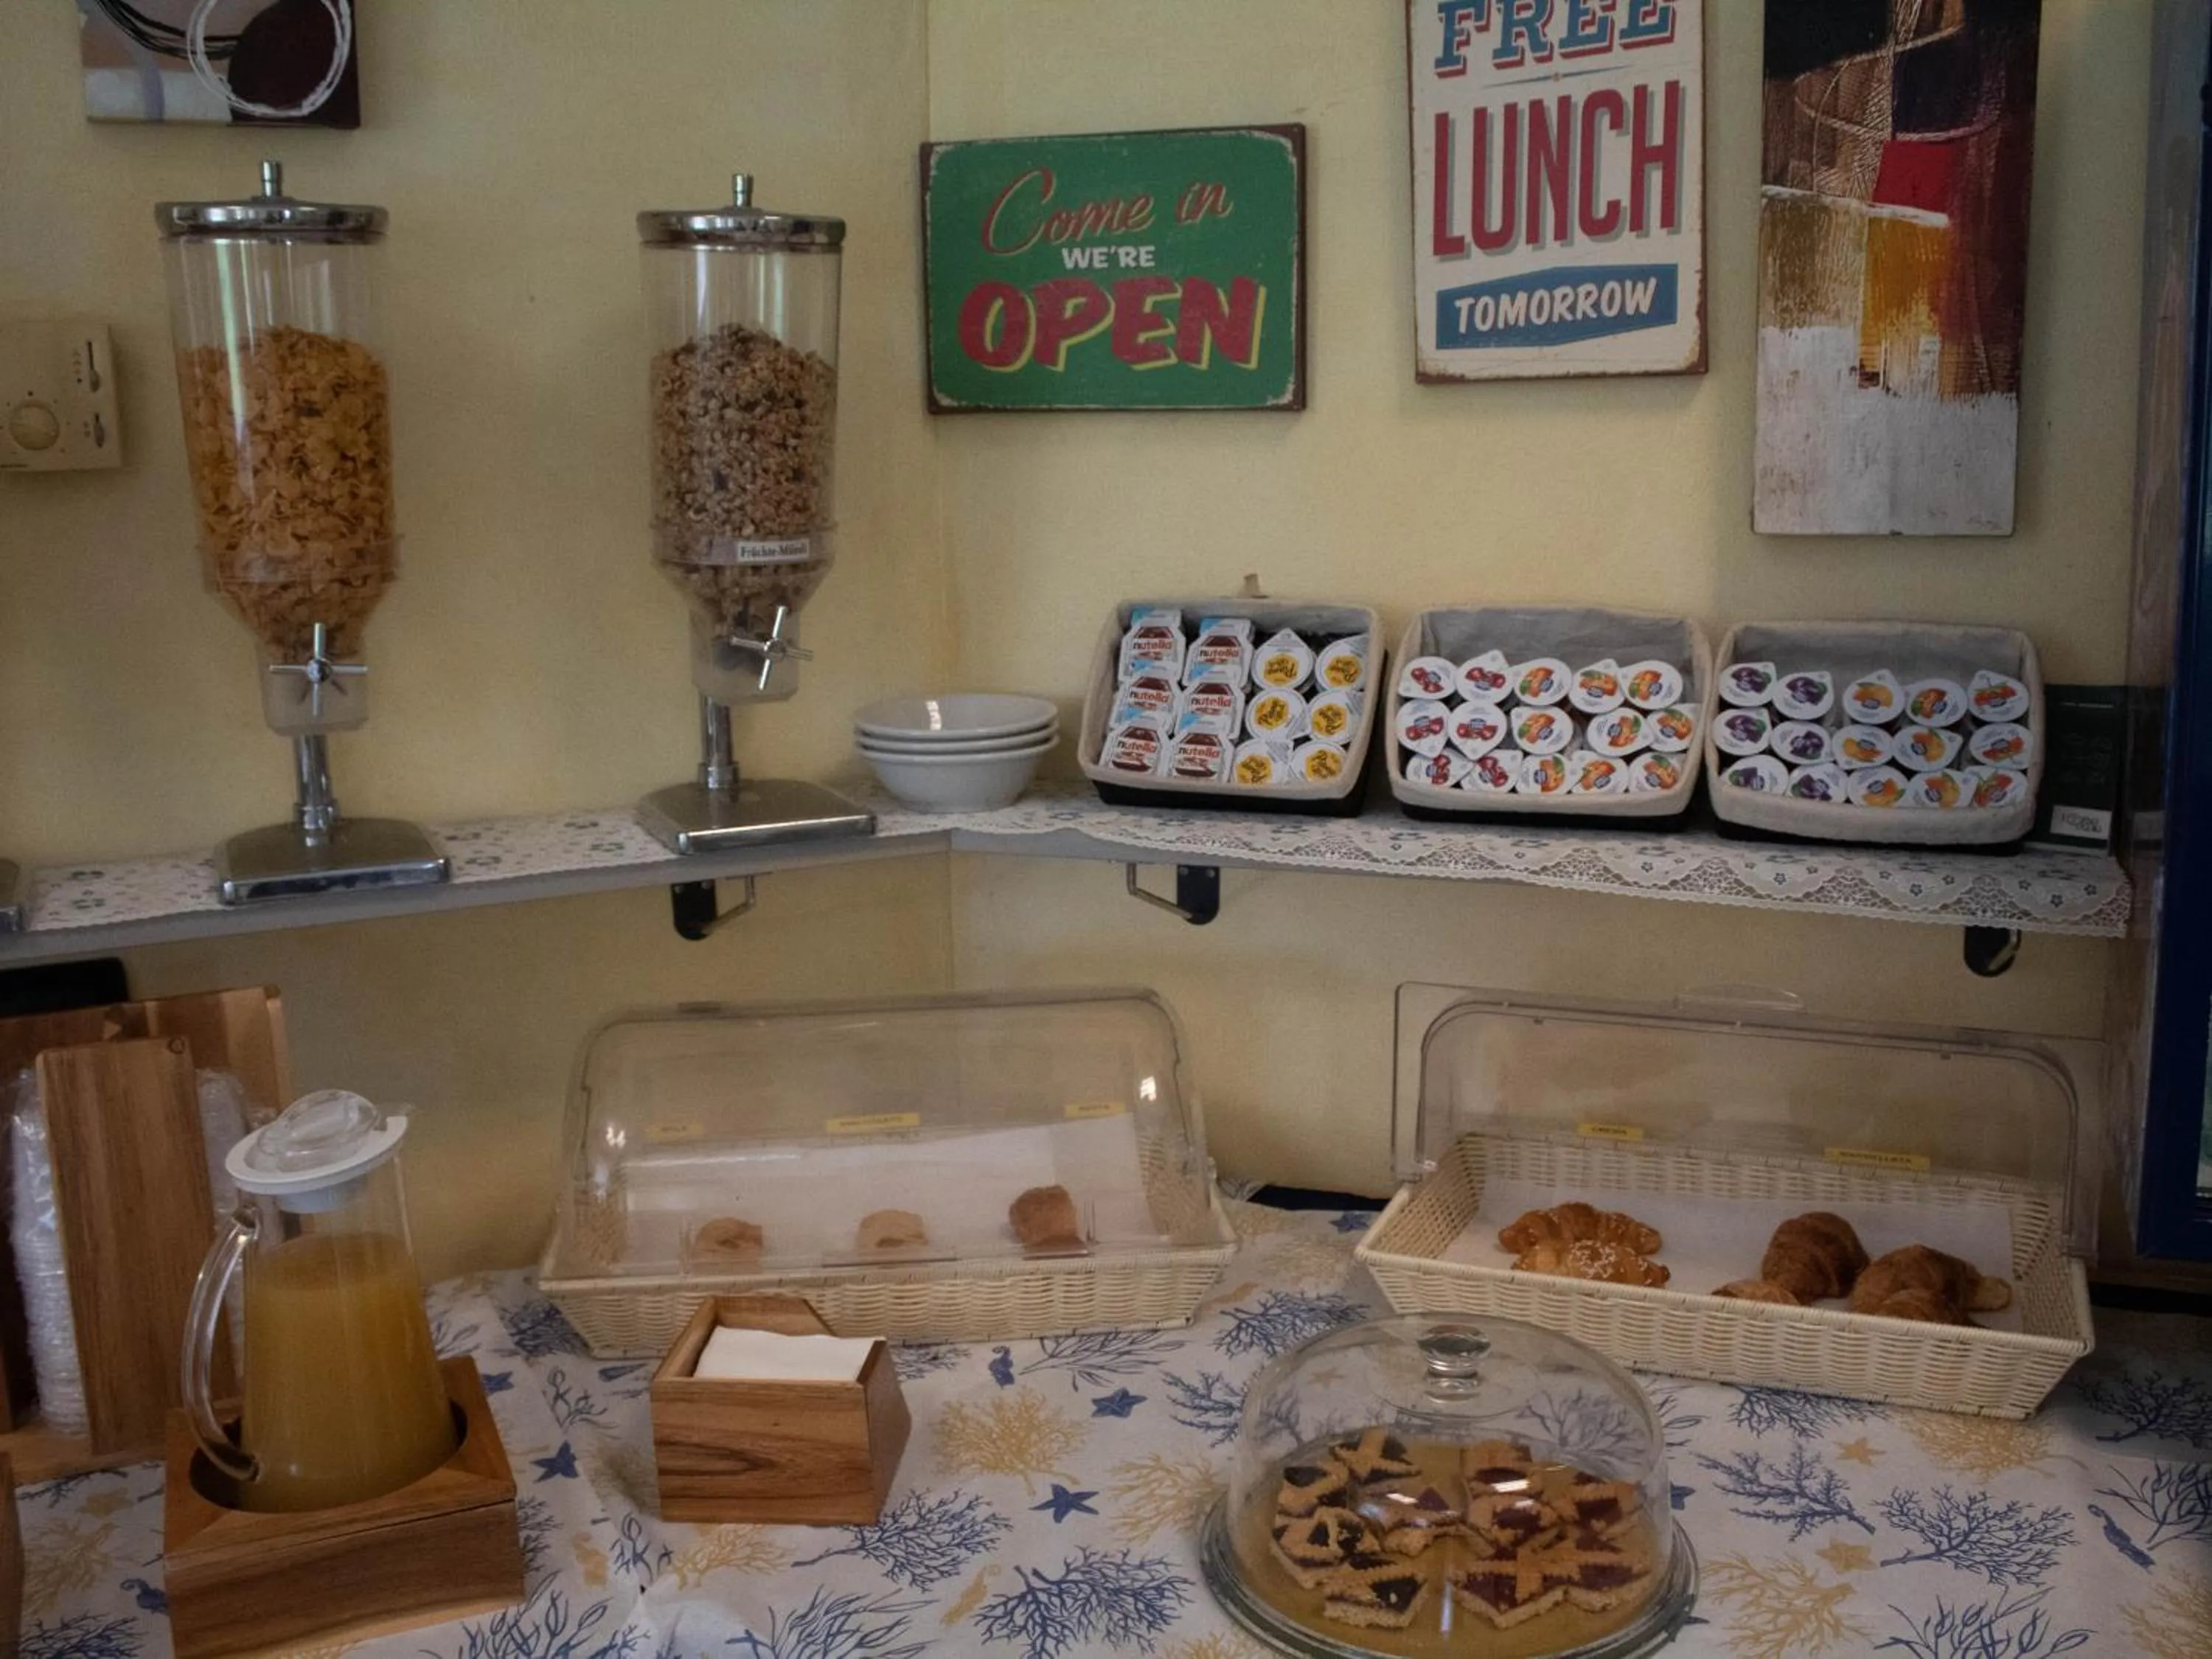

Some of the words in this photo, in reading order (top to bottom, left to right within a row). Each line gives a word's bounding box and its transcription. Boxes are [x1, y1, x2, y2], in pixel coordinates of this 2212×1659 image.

[1434, 0, 1676, 77] FREE
[1433, 80, 1683, 260] LUNCH
[984, 167, 1156, 255] Come
[1178, 181, 1234, 224] in
[1062, 246, 1155, 271] WE'RE
[1453, 276, 1658, 335] TOMORROW
[959, 274, 1267, 372] OPEN
[1133, 639, 1172, 651] nutella
[1200, 647, 1239, 658] nutella
[1130, 690, 1169, 703] nutella
[1191, 695, 1231, 707] nutella
[1117, 740, 1157, 754] nutella
[1179, 745, 1220, 759] nutella
